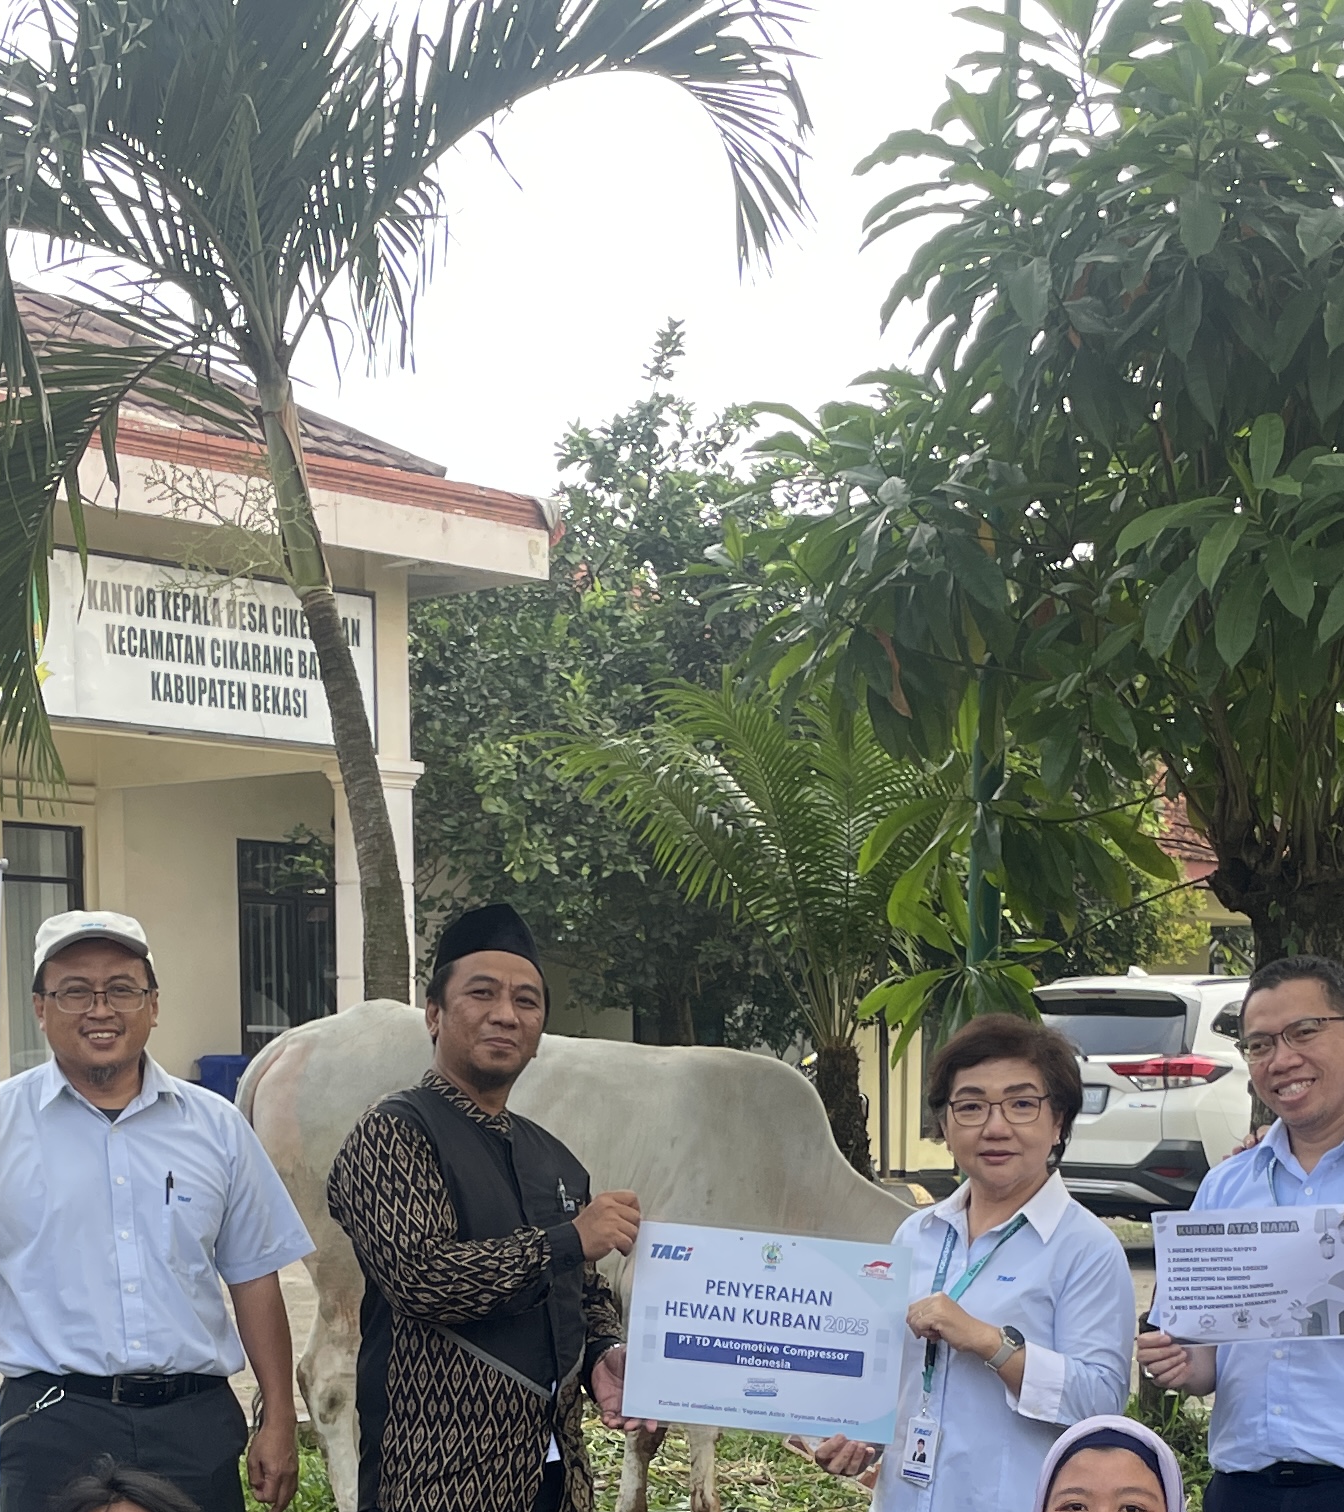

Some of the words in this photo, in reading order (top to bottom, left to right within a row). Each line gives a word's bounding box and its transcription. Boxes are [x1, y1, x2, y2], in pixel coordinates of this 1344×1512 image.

[87, 579, 156, 619] KANTOR
[161, 590, 222, 628] KEPALA
[105, 623, 205, 666] KECAMATAN
[210, 637, 293, 678] CIKARANG
[151, 670, 247, 712] KABUPATEN
[252, 683, 308, 718] BEKASI
[1227, 1222, 1258, 1235] ATAS
[1261, 1221, 1300, 1234] NAMA
[705, 1279, 833, 1307] PENYERAHAN
[665, 1300, 736, 1323] HEWAN
[742, 1308, 822, 1331] KURBAN
[823, 1315, 869, 1336] 2025
[678, 1334, 692, 1345] PT
[695, 1336, 710, 1347] TD
[713, 1338, 780, 1354] Automotive
[782, 1345, 850, 1361] Compressor
[736, 1354, 791, 1369] Indonesia
